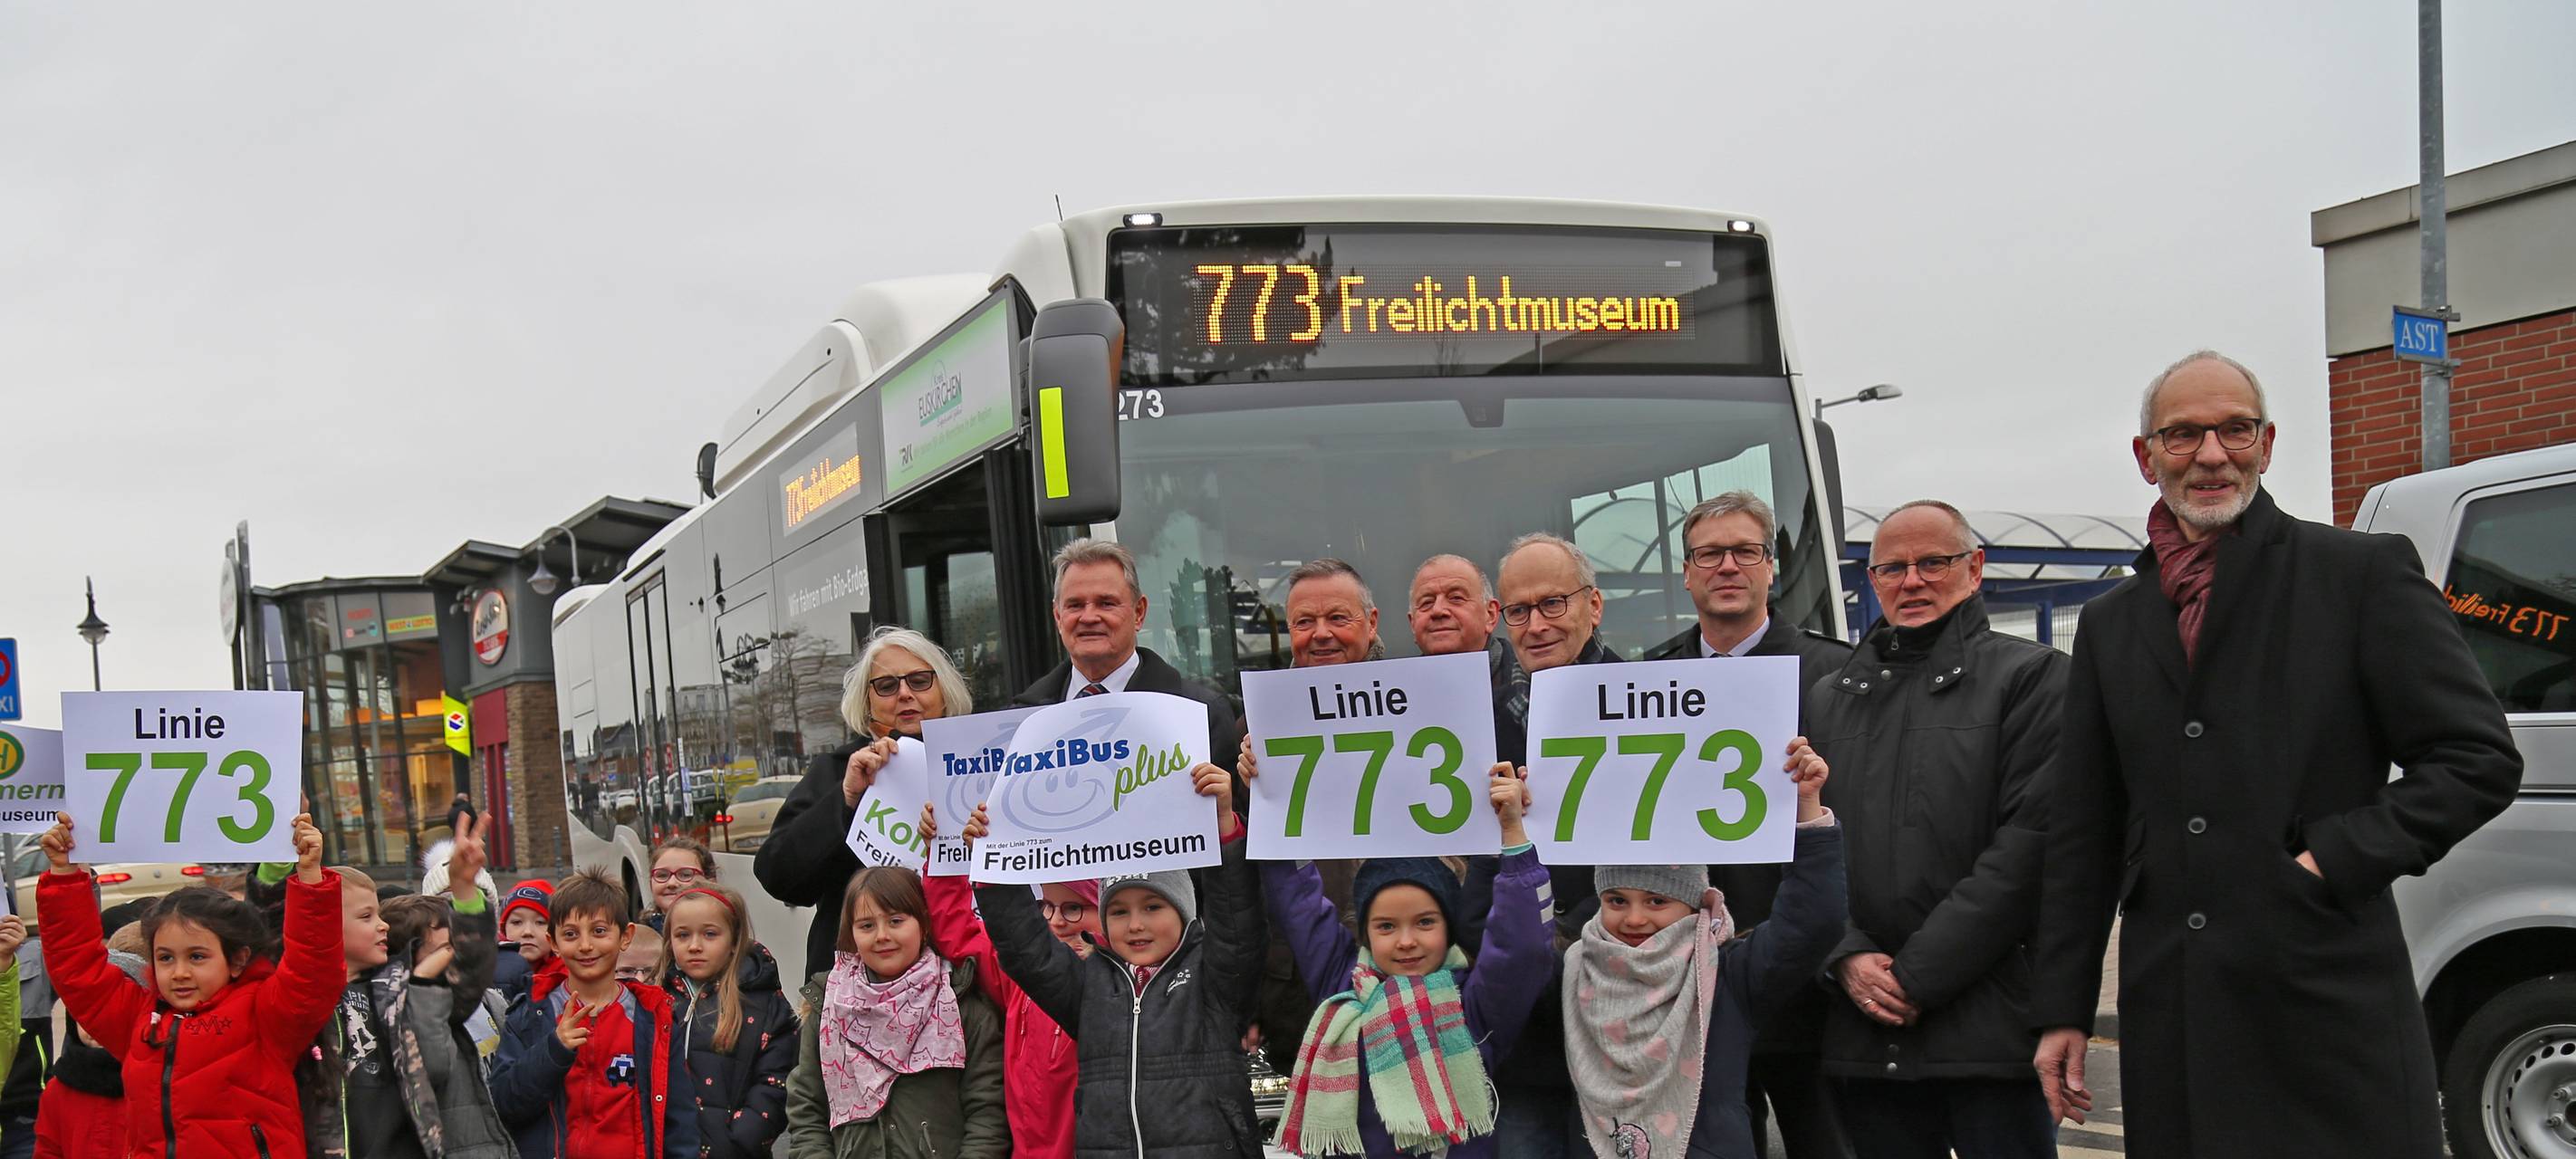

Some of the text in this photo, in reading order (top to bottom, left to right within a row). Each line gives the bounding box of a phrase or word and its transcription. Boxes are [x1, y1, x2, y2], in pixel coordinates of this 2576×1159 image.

[1197, 264, 1680, 342] 773 Freilichtmuseum
[2399, 320, 2438, 352] AST
[918, 370, 962, 420] EUSKIRCHEN
[1309, 681, 1408, 721] Linie
[1598, 681, 1706, 721] Linie
[135, 708, 226, 740] Linie
[1004, 738, 1130, 777] TaxiBus
[1112, 742, 1190, 811] plus
[86, 750, 274, 844] 773
[1265, 726, 1472, 838] 773
[1541, 729, 1767, 842] 773
[984, 834, 1206, 872] Freilichtmuseum
[1009, 840, 1025, 848] Linie
[1026, 838, 1038, 847] 773
